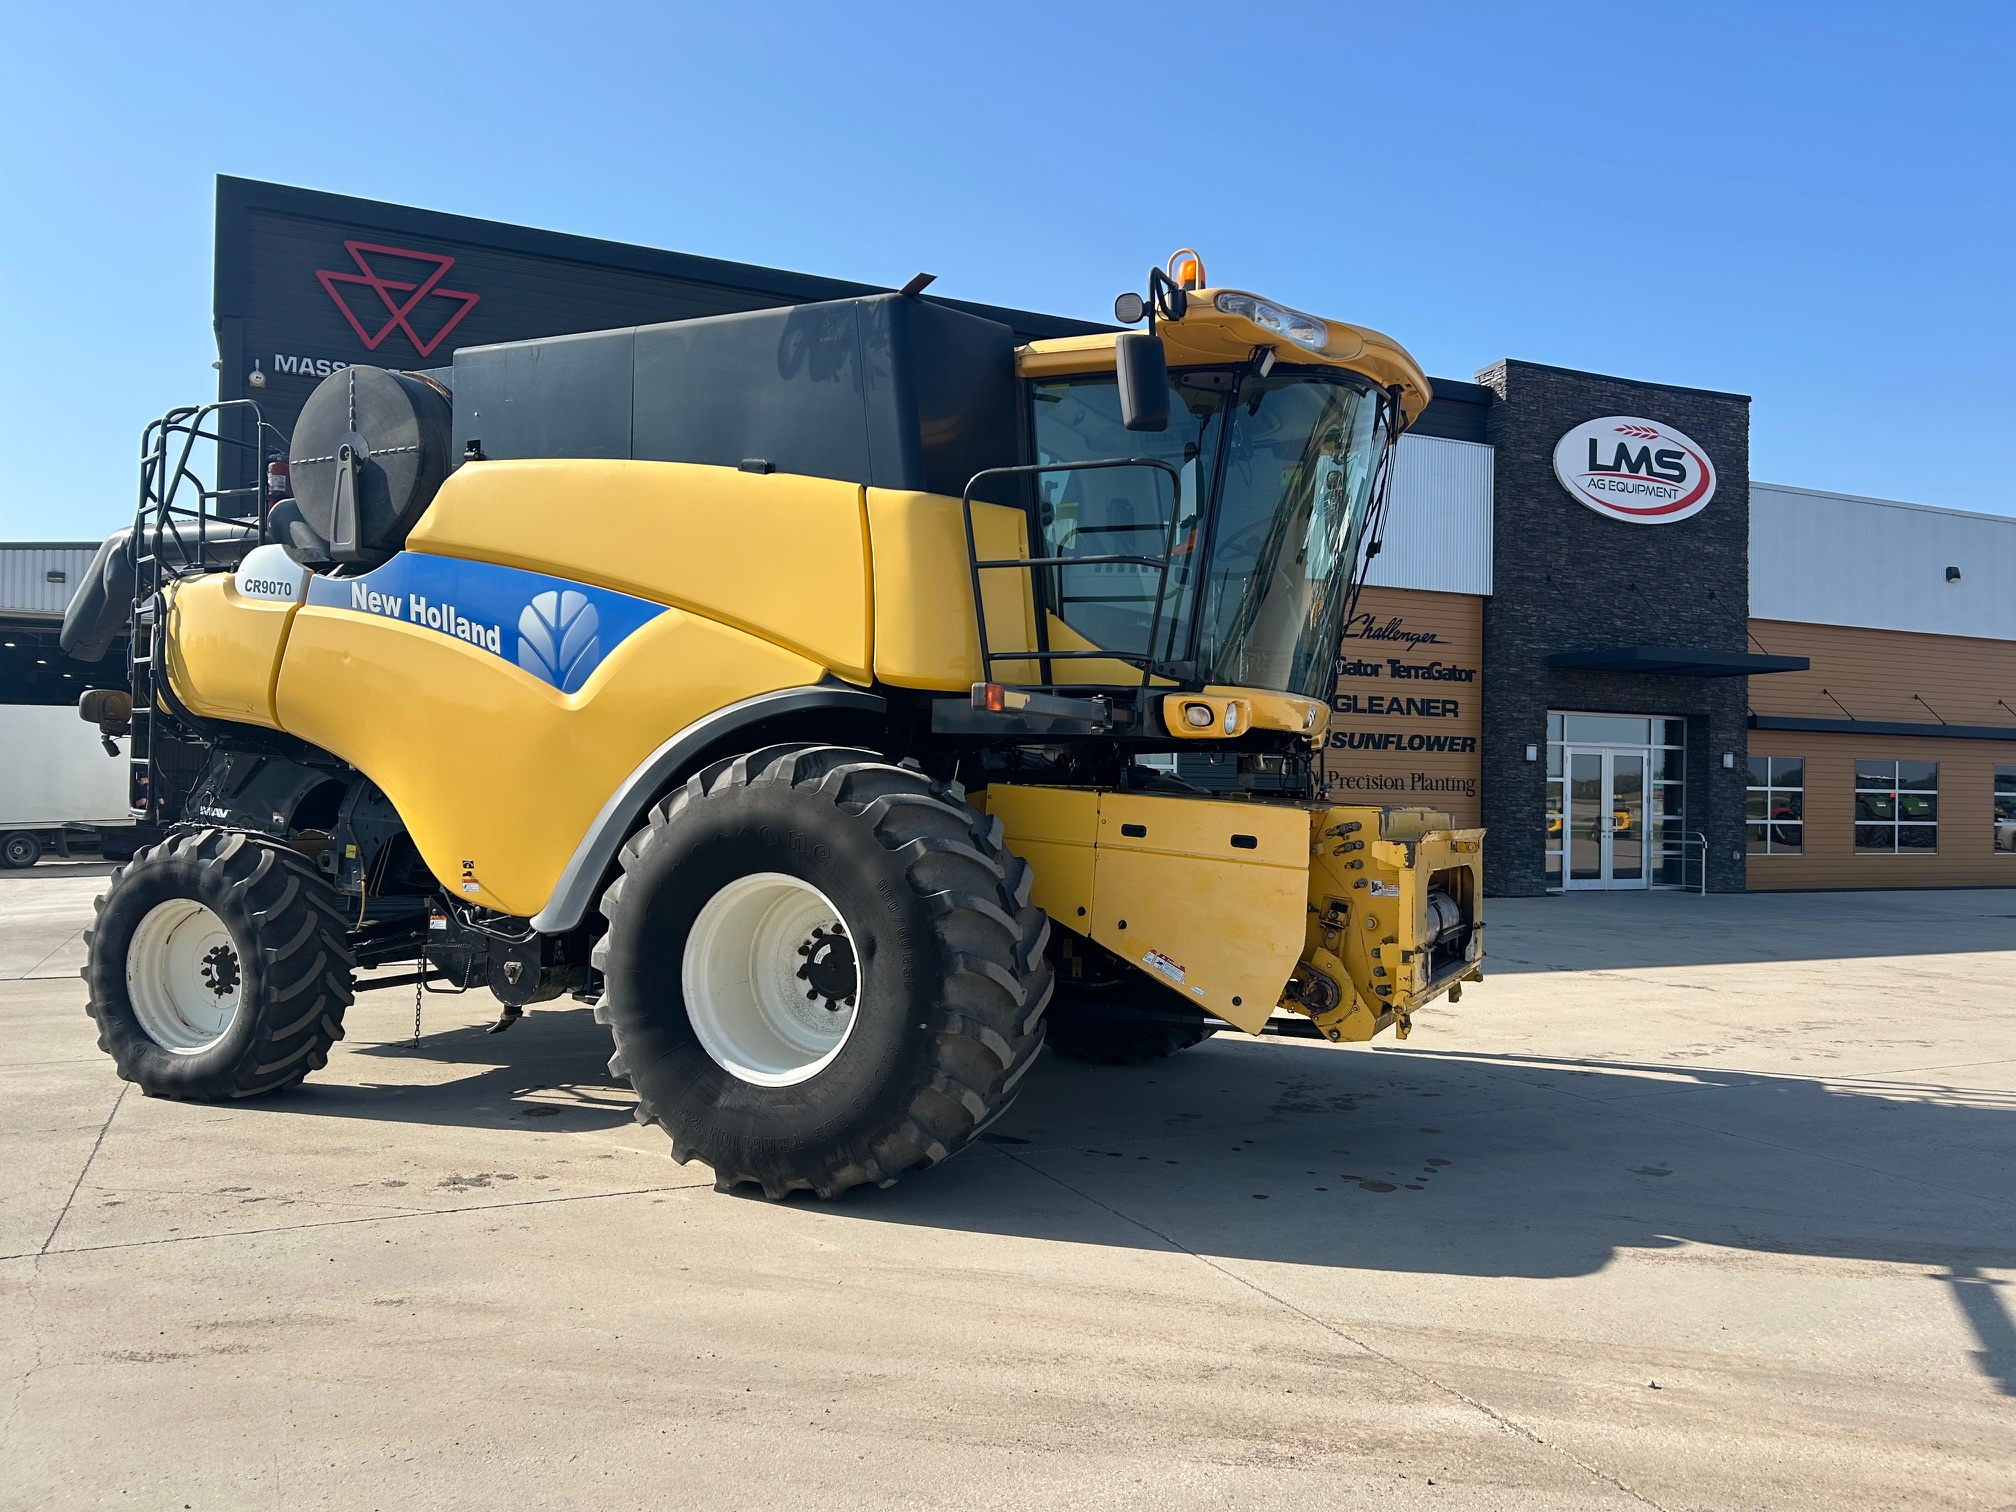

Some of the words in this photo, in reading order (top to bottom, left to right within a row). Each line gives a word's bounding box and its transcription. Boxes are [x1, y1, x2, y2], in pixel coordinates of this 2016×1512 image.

[274, 353, 358, 377] MASS
[1588, 437, 1687, 484] LMS
[1587, 477, 1606, 490] AG
[1608, 480, 1679, 500] EQUIPMENT
[244, 577, 293, 597] CR9070
[350, 581, 403, 617] New
[409, 594, 502, 655] Holland
[1343, 612, 1453, 652] Challenger
[1387, 658, 1476, 683] TerraGator
[1333, 694, 1459, 718] GLEANER
[1330, 731, 1476, 753] SUNFLOWER
[1328, 770, 1405, 791] Precision
[1410, 772, 1476, 798] Planting
